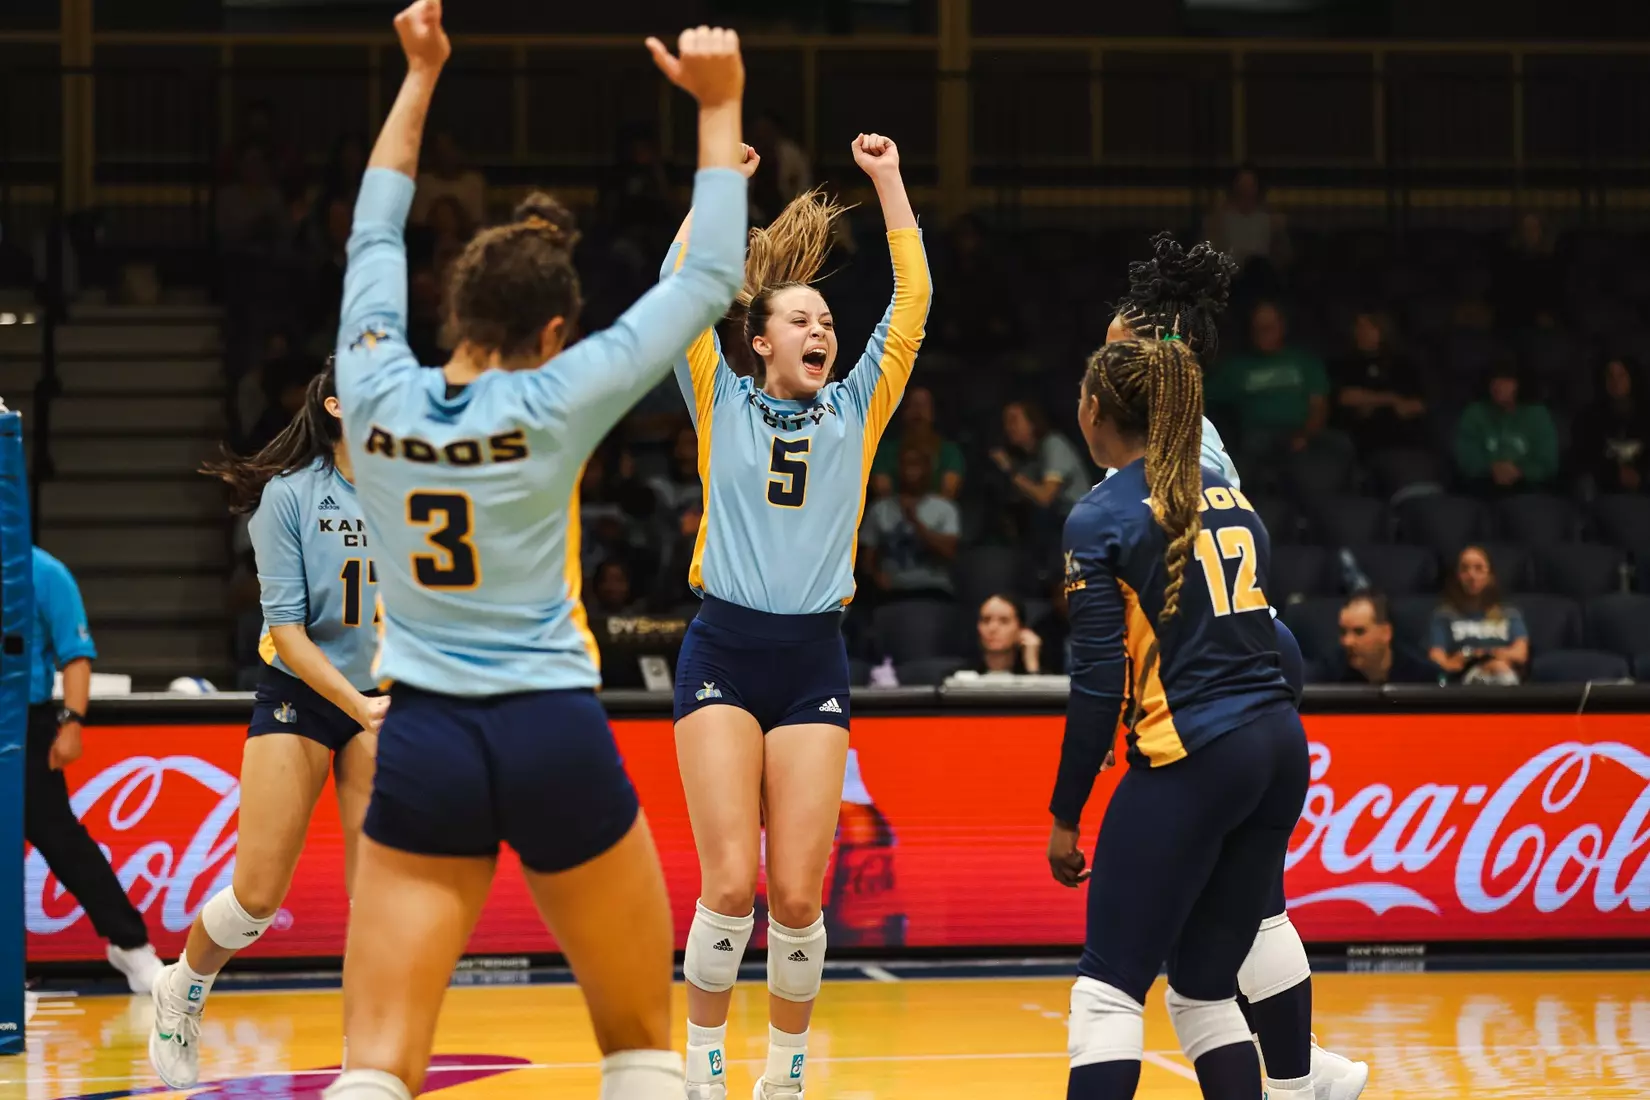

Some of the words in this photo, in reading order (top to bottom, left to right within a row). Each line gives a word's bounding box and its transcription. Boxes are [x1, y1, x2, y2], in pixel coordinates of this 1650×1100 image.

[365, 425, 529, 466] ROOS
[763, 413, 824, 430] CITY
[766, 435, 811, 508] 5
[406, 487, 482, 592] 3
[1193, 526, 1269, 617] 12
[818, 706, 843, 714] adidas
[1285, 741, 1650, 914] oca-Col
[713, 944, 734, 952] adidas
